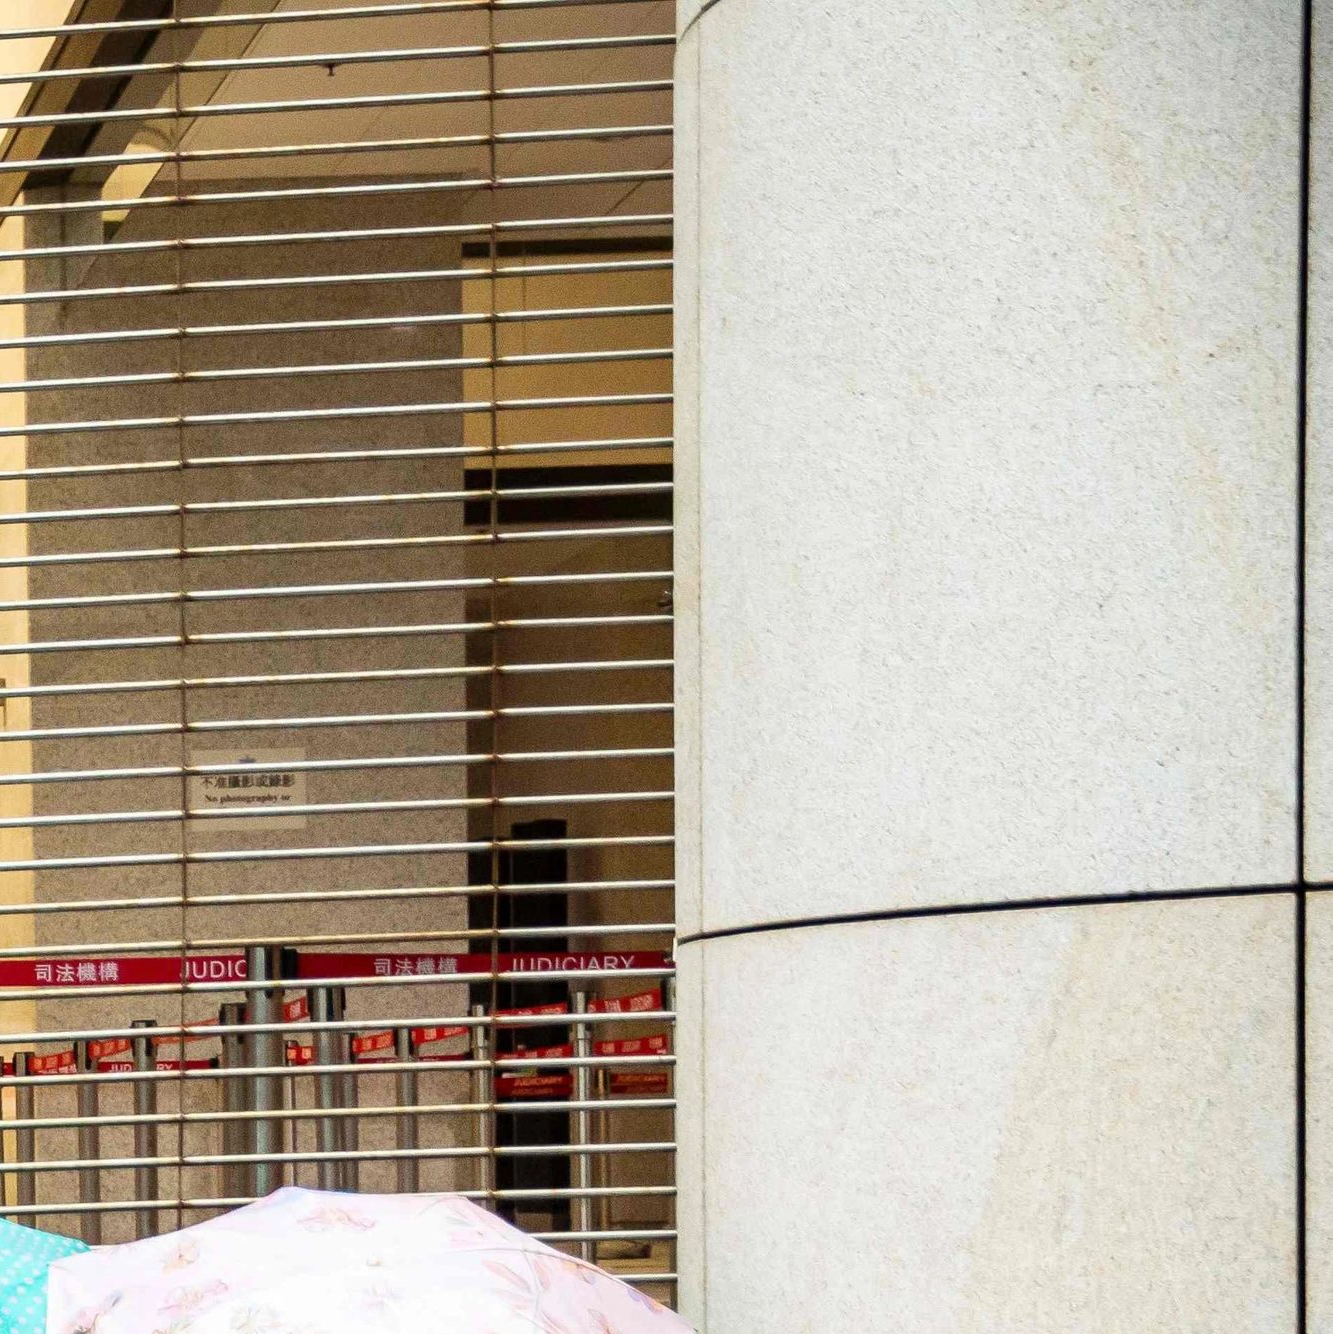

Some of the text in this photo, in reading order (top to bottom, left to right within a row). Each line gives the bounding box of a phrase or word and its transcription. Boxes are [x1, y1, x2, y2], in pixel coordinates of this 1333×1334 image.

[34, 962, 120, 982] 司法機構
[373, 957, 459, 977] 司法機構
[506, 955, 635, 973] JUDICIARY
